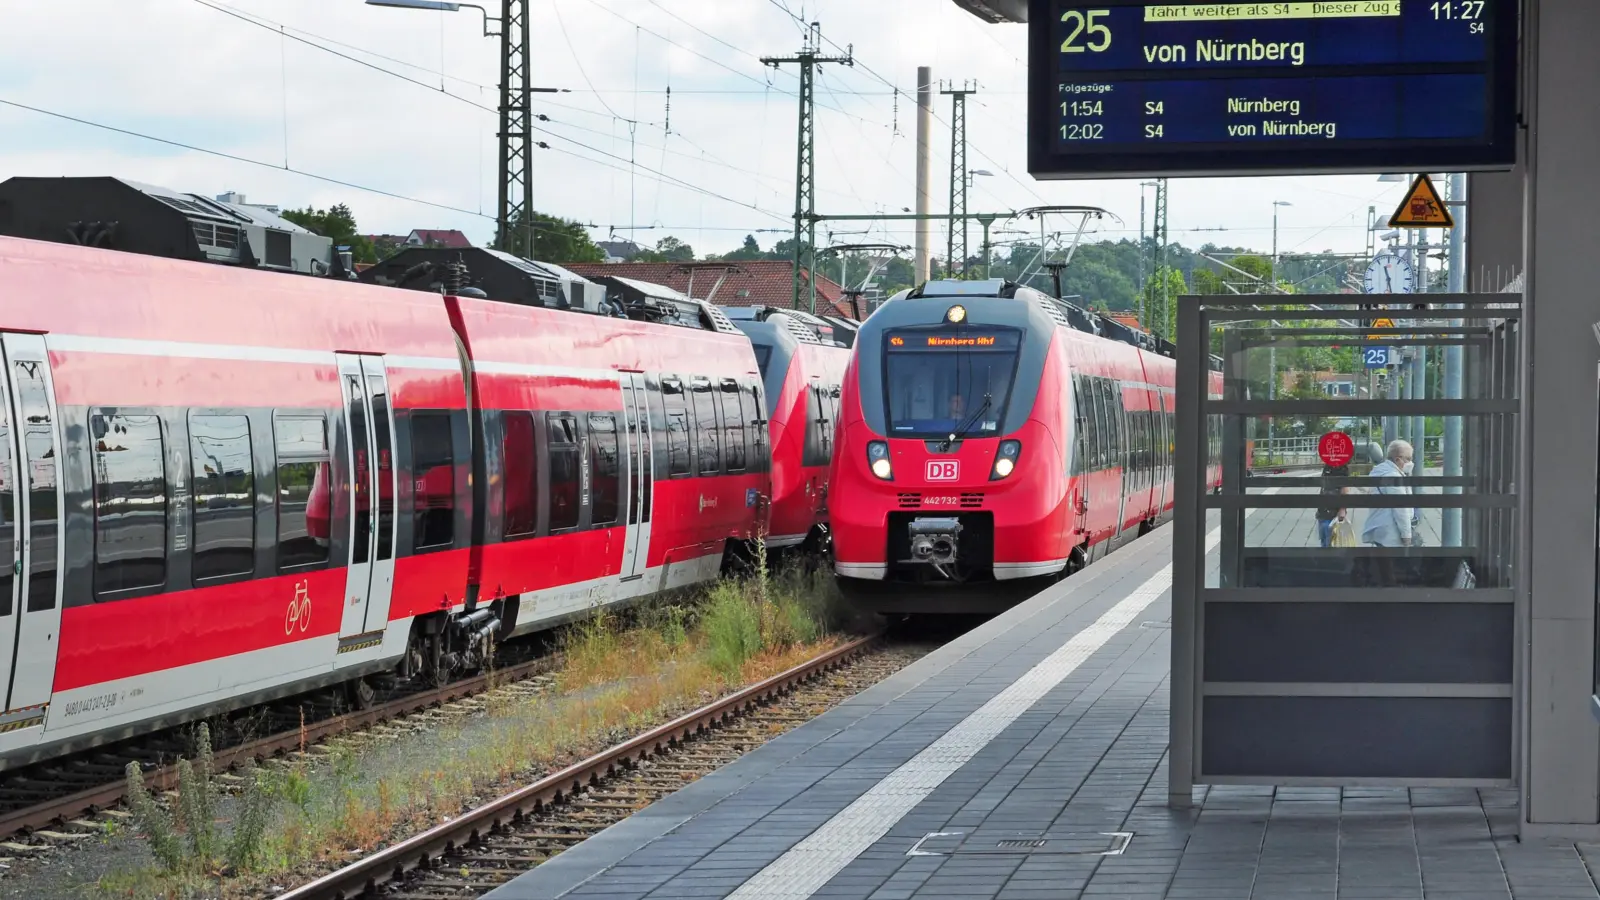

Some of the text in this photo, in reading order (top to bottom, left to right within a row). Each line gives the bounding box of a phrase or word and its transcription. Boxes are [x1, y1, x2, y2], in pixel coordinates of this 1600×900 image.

[1192, 5, 1240, 17] weiter
[1247, 5, 1268, 15] als
[1273, 4, 1290, 15] S4
[1312, 3, 1358, 14] Dieser
[1364, 2, 1389, 14] Zug
[1430, 1, 1485, 20] 11:27
[1060, 9, 1112, 53] 25
[1469, 22, 1484, 34] S4
[1143, 38, 1305, 66] von Nürnberg
[1058, 83, 1114, 94] Folgezüge:
[1060, 97, 1300, 116] 11:54 S4 Nürnberg
[1060, 120, 1336, 140] 12:02 S4 von Nürnberg
[1366, 349, 1386, 364] 25
[929, 463, 956, 478] DB
[924, 496, 957, 505] 442 732
